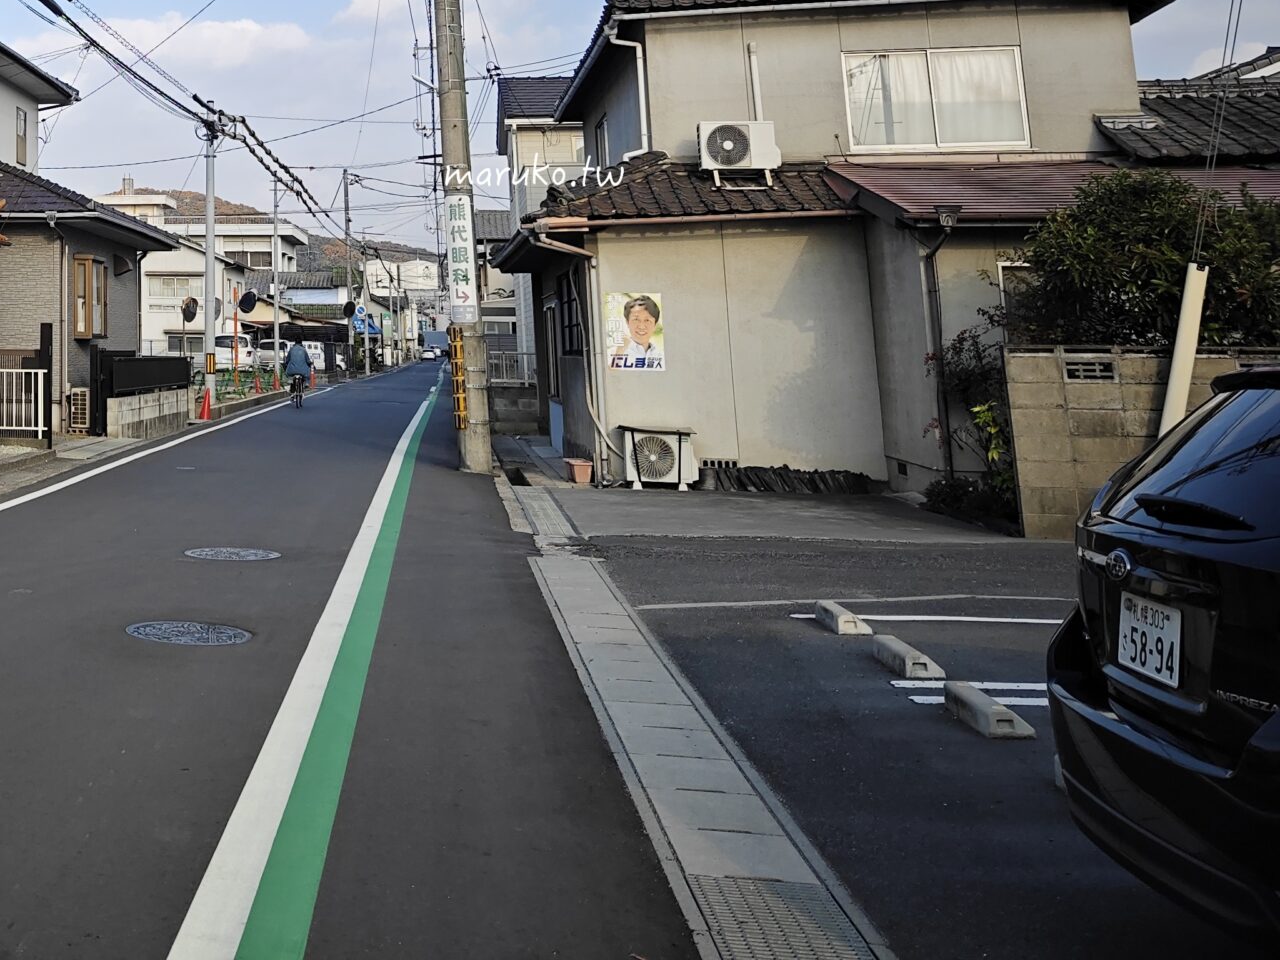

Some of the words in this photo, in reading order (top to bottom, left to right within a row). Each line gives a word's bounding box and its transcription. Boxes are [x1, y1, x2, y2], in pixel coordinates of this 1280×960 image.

[449, 203, 470, 286] 熊代眼科
[1130, 626, 1175, 680] 58-94
[1216, 689, 1280, 713] IMPREZA
